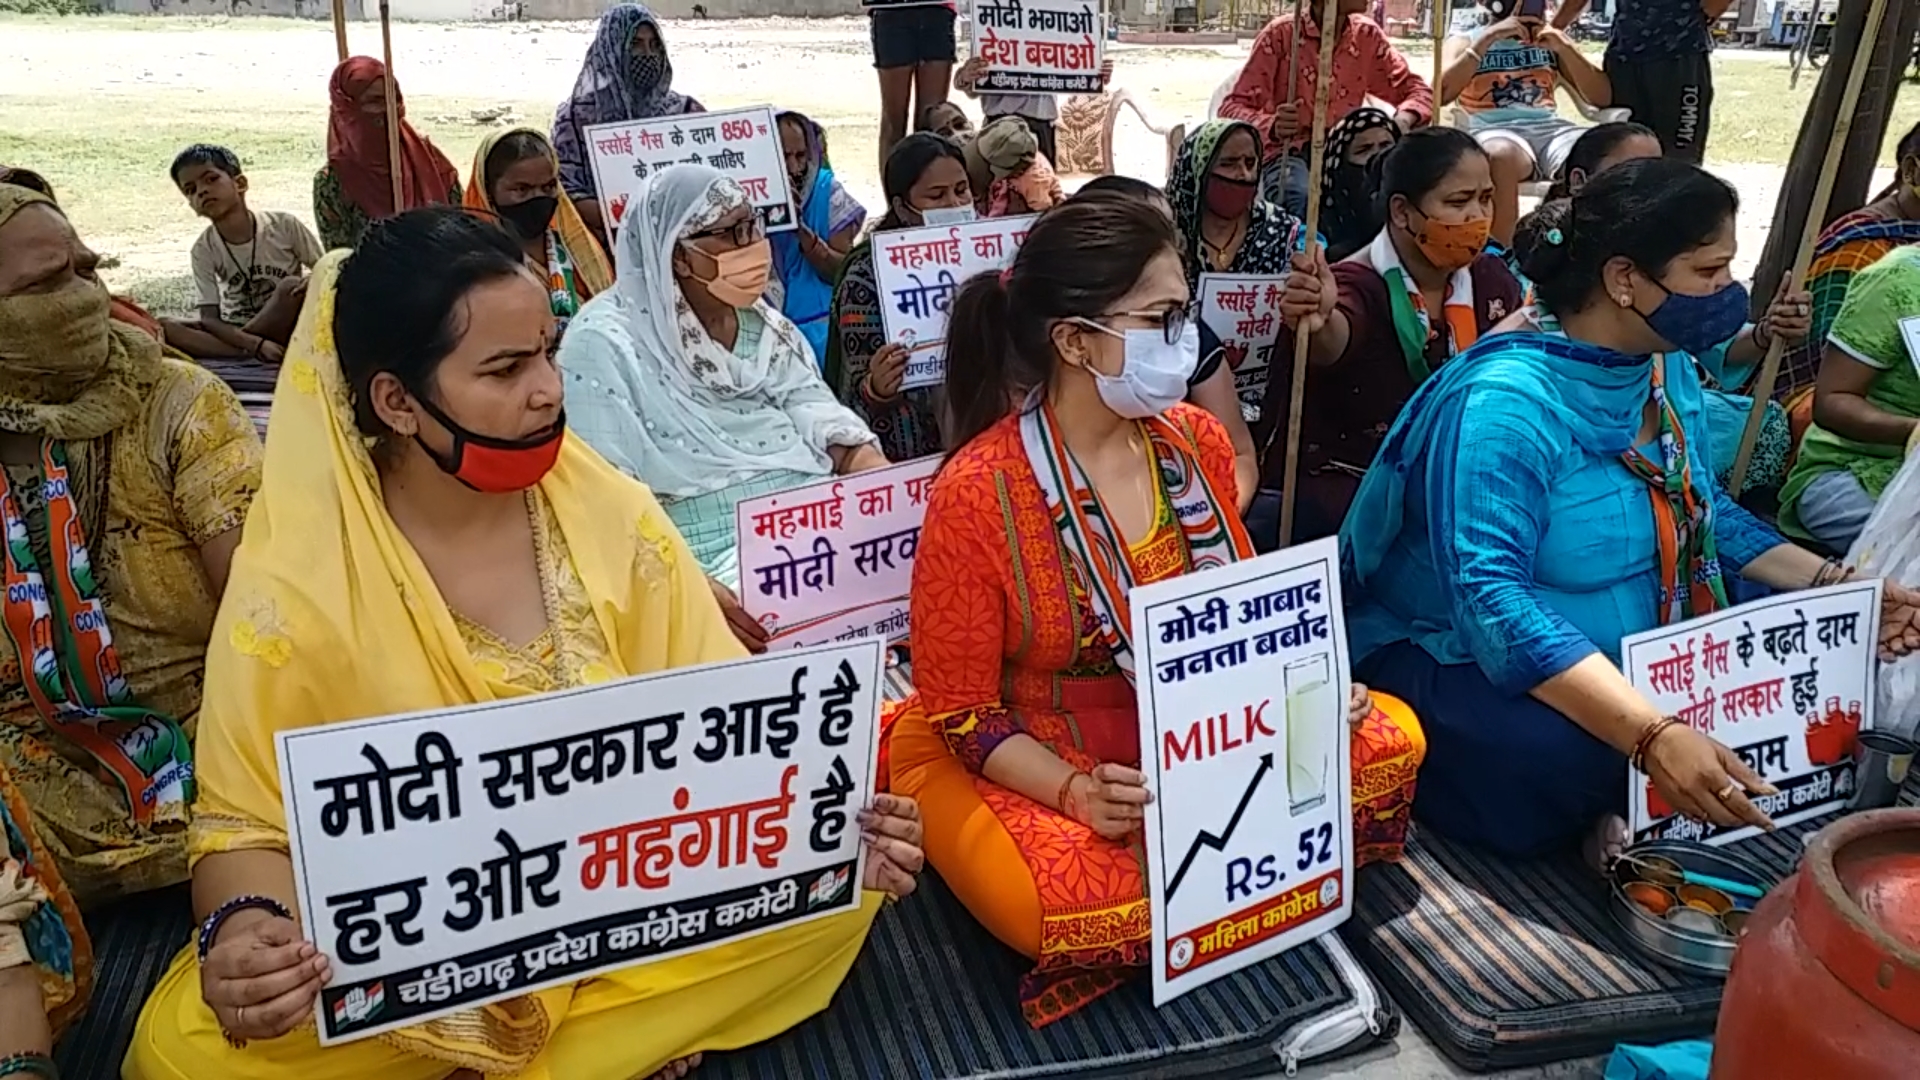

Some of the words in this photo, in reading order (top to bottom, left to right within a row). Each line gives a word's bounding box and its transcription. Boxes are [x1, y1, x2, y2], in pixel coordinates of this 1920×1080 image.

[977, 0, 1023, 29] मोदी
[1028, 4, 1093, 34] भगाओ
[979, 27, 1019, 66] देश
[1024, 34, 1095, 70] बचाओ
[1480, 49, 1526, 69] KATER'S
[596, 130, 634, 156] रसोई
[638, 128, 665, 151] गैस
[669, 125, 685, 147] के
[690, 126, 716, 145] दाम
[721, 119, 754, 141] 850
[633, 158, 648, 180] के
[970, 233, 1003, 260] का
[1216, 284, 1261, 315] रसोई
[1236, 311, 1274, 339] मोदी
[751, 483, 845, 541] मंहगाई
[855, 484, 895, 517] का
[754, 536, 839, 600] मोदी
[850, 526, 922, 577] सरक
[8, 583, 46, 605] CONG
[1158, 597, 1230, 644] मोदी
[1238, 578, 1322, 625] आबाद
[1156, 638, 1249, 684] जनता
[1252, 609, 1328, 656] बर्बाद
[1648, 638, 1696, 696] रसोई
[1702, 632, 1731, 680] गैस
[1736, 621, 1755, 667] के
[1762, 608, 1808, 666] बढ़ते
[1816, 611, 1860, 651] दाम
[1678, 686, 1717, 734] मोदी
[1722, 677, 1785, 723] सरकार
[1790, 656, 1820, 717] हुई
[314, 730, 463, 838] मोदी
[479, 710, 685, 810] सरकार
[693, 665, 808, 763] आई
[819, 658, 861, 747] है
[1163, 699, 1277, 771] MILK
[142, 761, 193, 806] CONGRES
[1792, 771, 1832, 806] कमेटी
[325, 876, 428, 966] हर
[443, 827, 567, 933] ओर
[578, 764, 799, 891] महंगाई
[809, 754, 855, 853] है
[1225, 854, 1287, 903] Rs.
[1296, 821, 1333, 871] 52
[398, 953, 518, 1005] चंडीगढ़
[522, 931, 601, 980] प्रदेश
[607, 906, 710, 948] कांग्रेस
[715, 878, 800, 928] कमेटी
[1198, 916, 1260, 955] महिला
[1262, 889, 1319, 929] कांग्रेस
